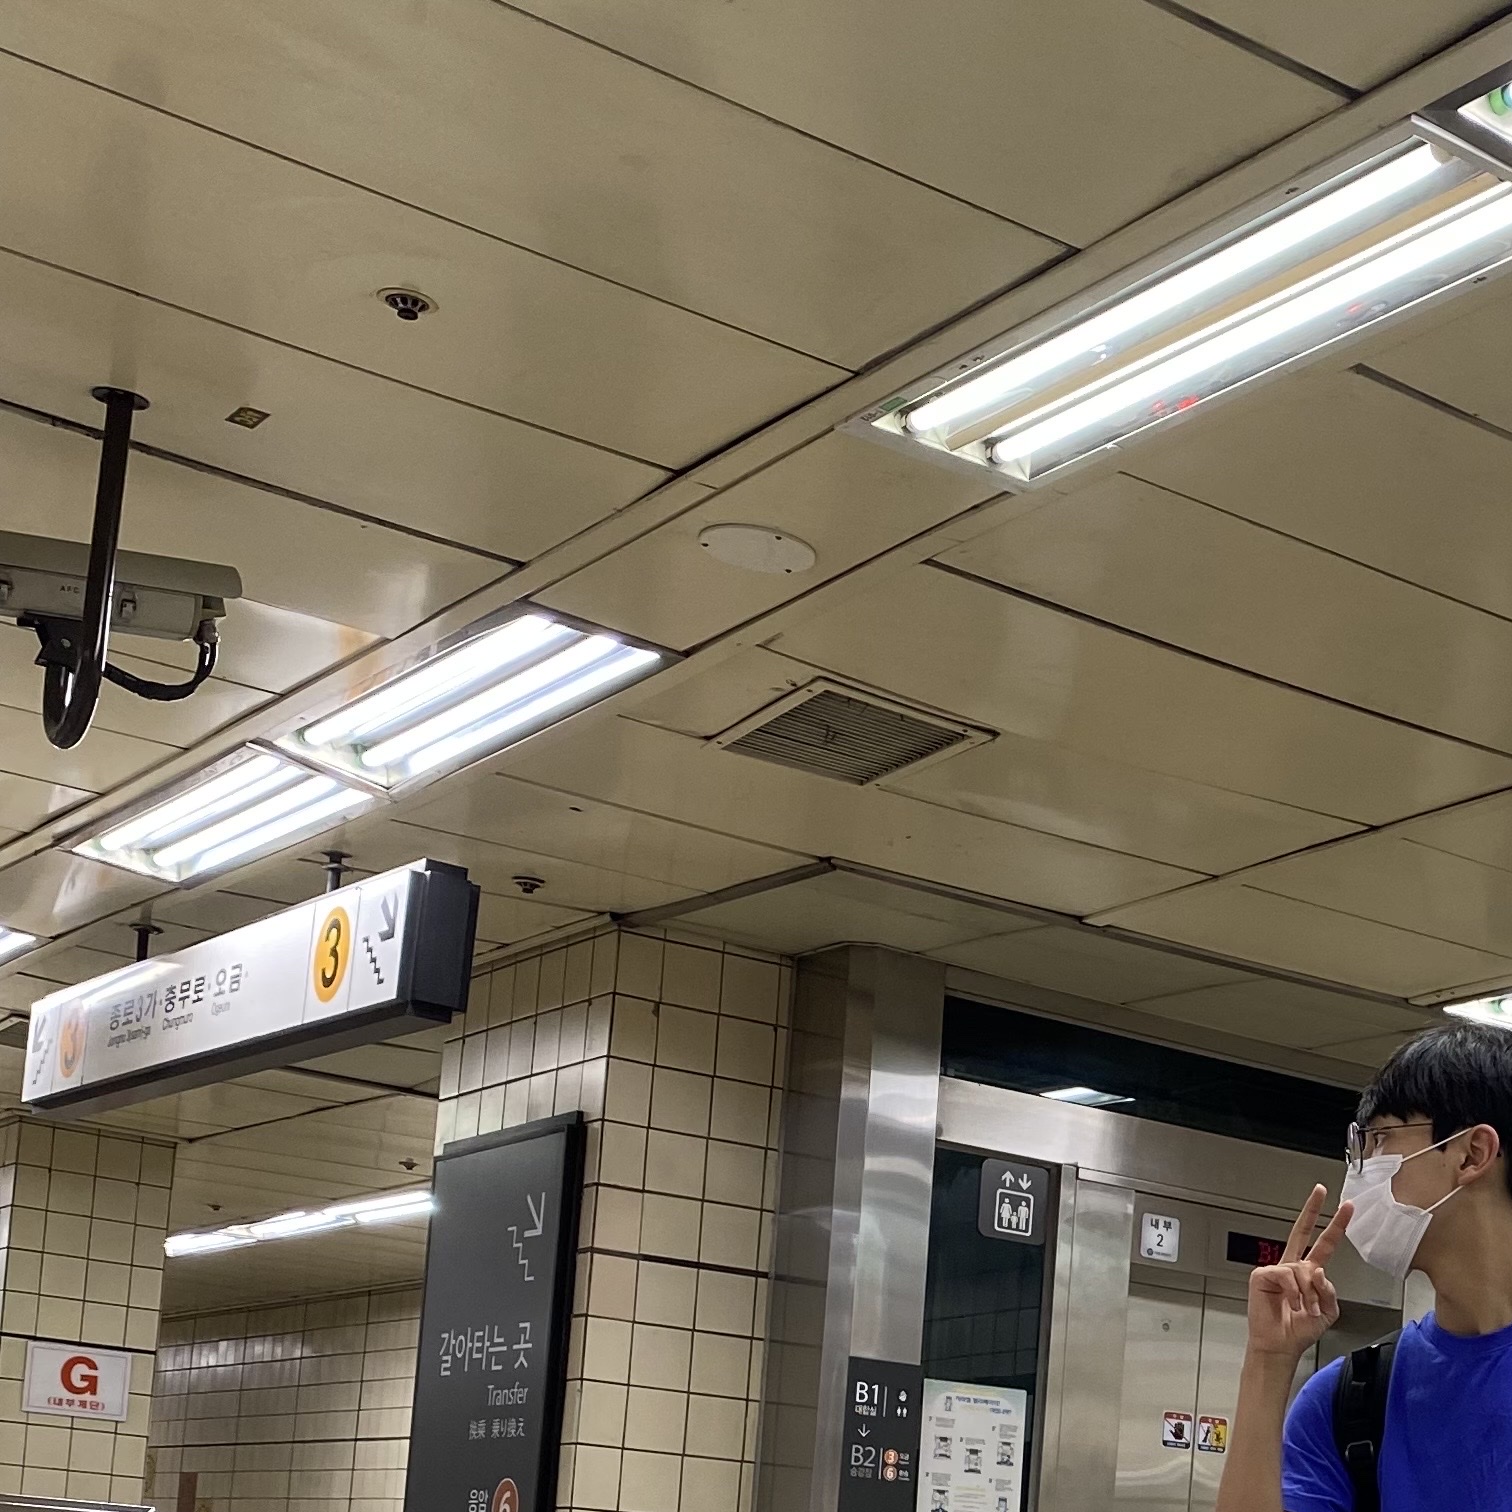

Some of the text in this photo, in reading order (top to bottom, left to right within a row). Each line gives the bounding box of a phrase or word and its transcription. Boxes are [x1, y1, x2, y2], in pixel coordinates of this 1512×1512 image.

[321, 918, 342, 988] 3
[1156, 1234, 1164, 1247] 2
[440, 1322, 533, 1376] 갈아타는 곳
[60, 1356, 99, 1396] G
[487, 1381, 529, 1406] Transfer
[855, 1381, 879, 1405] B1
[851, 1444, 876, 1467] B2
